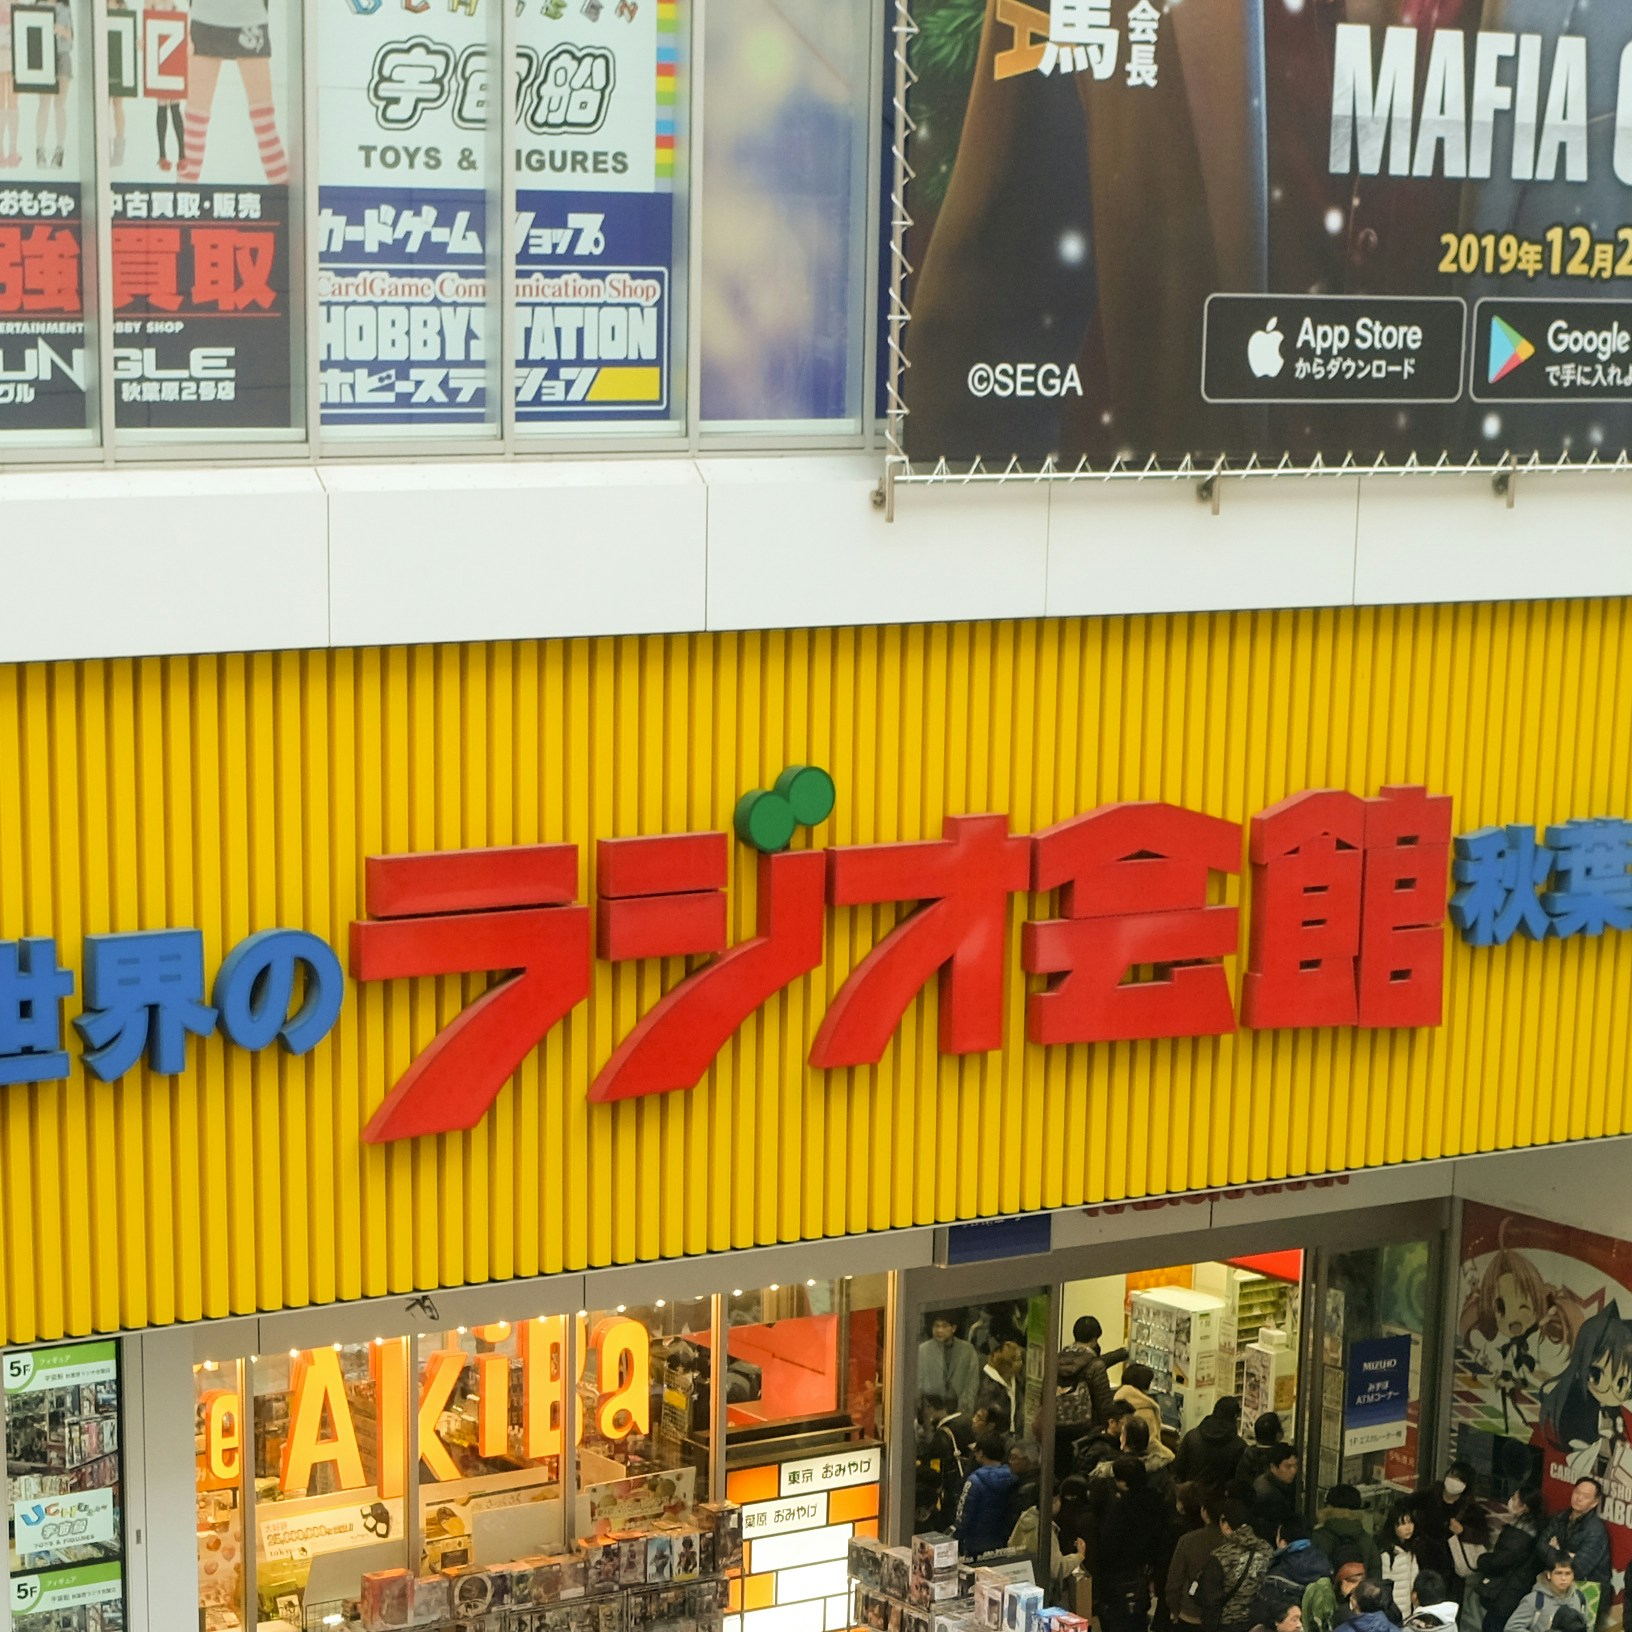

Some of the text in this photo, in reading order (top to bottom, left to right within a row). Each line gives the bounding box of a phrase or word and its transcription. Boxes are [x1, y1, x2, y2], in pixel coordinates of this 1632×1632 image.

[1328, 23, 1588, 184] MAFIA
[358, 146, 629, 174] TOYS & IGURES
[317, 274, 658, 303] CardGame Comunication Shop
[147, 320, 184, 334] SHOP
[1295, 317, 1423, 356] App Store
[1547, 320, 1630, 361] Google
[968, 362, 1083, 398] ©SEGA
[1294, 356, 1416, 381] からダウンロード
[121, 380, 236, 402] 秋葉原2号店
[319, 367, 599, 404] ホビーステション
[349, 766, 1454, 1144] ラジオ会館
[9, 1359, 31, 1379] 5F
[1362, 1358, 1398, 1372] MIZUHO
[787, 1458, 872, 1486] 東京 おみやげ
[773, 1502, 818, 1524] おみやげ
[16, 1582, 38, 1600] 5F
